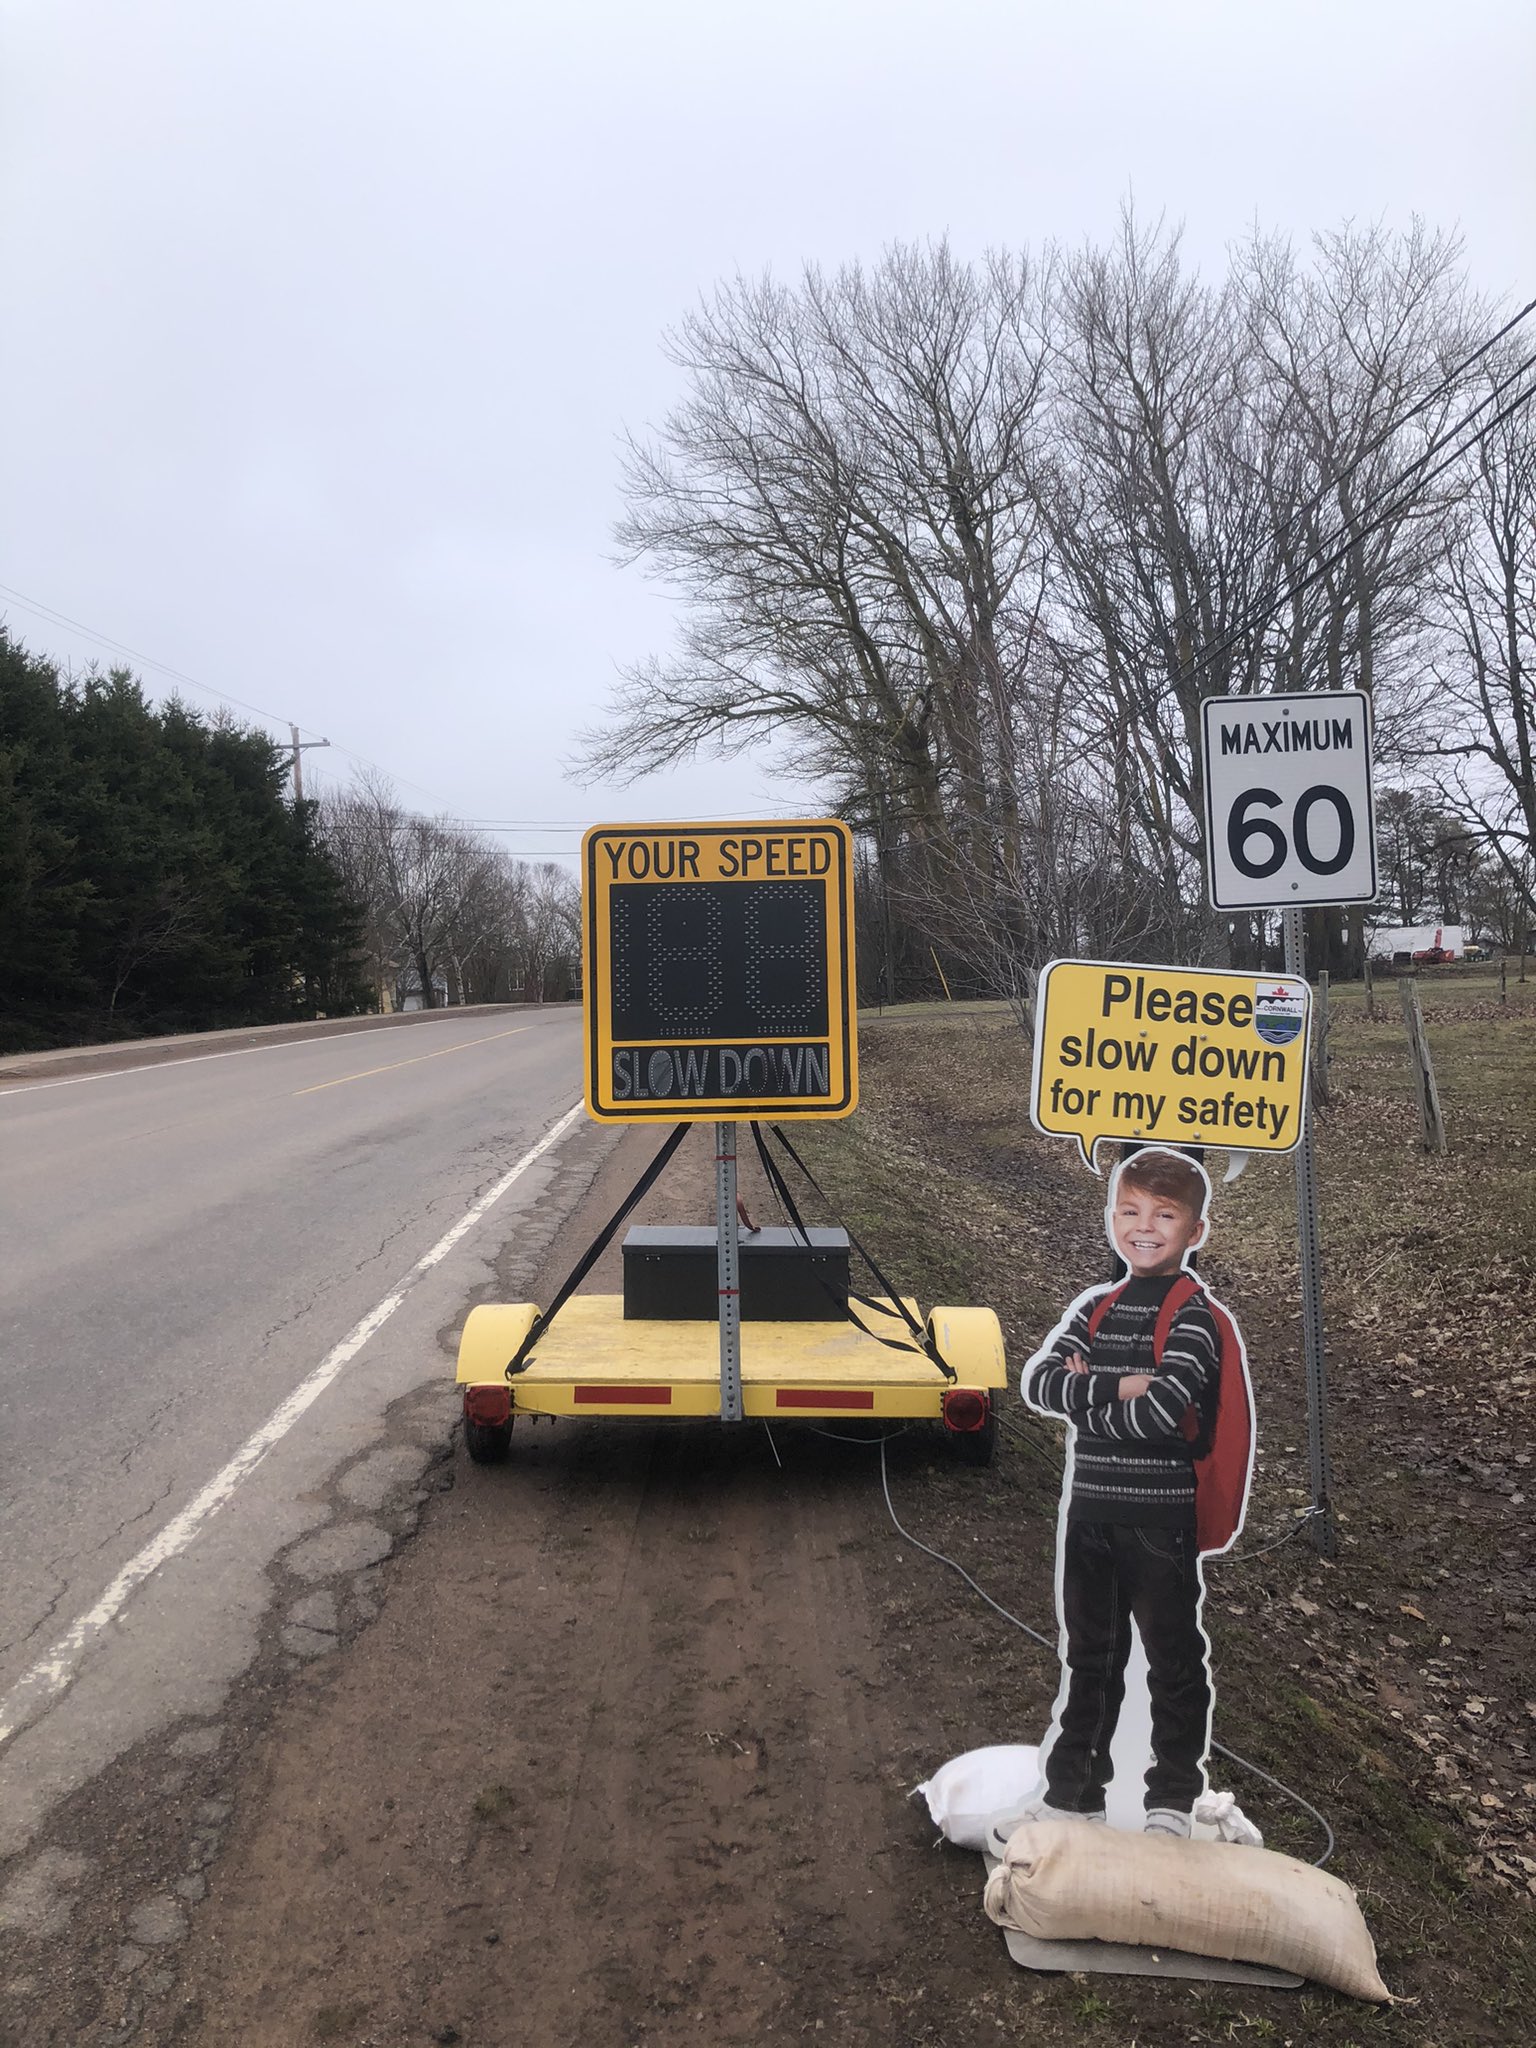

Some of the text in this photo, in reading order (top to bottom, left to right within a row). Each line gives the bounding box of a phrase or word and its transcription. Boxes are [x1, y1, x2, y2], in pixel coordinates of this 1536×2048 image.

[1220, 718, 1353, 755] MAXIMUM
[1227, 784, 1355, 879] 60
[603, 837, 831, 879] YOUR SPEED
[1101, 973, 1253, 1028] Please
[1263, 1005, 1298, 1014] CORNWALL
[613, 1047, 829, 1097] SLOW DOWN
[1059, 1027, 1286, 1082] slow down
[1050, 1078, 1289, 1140] for my safety
